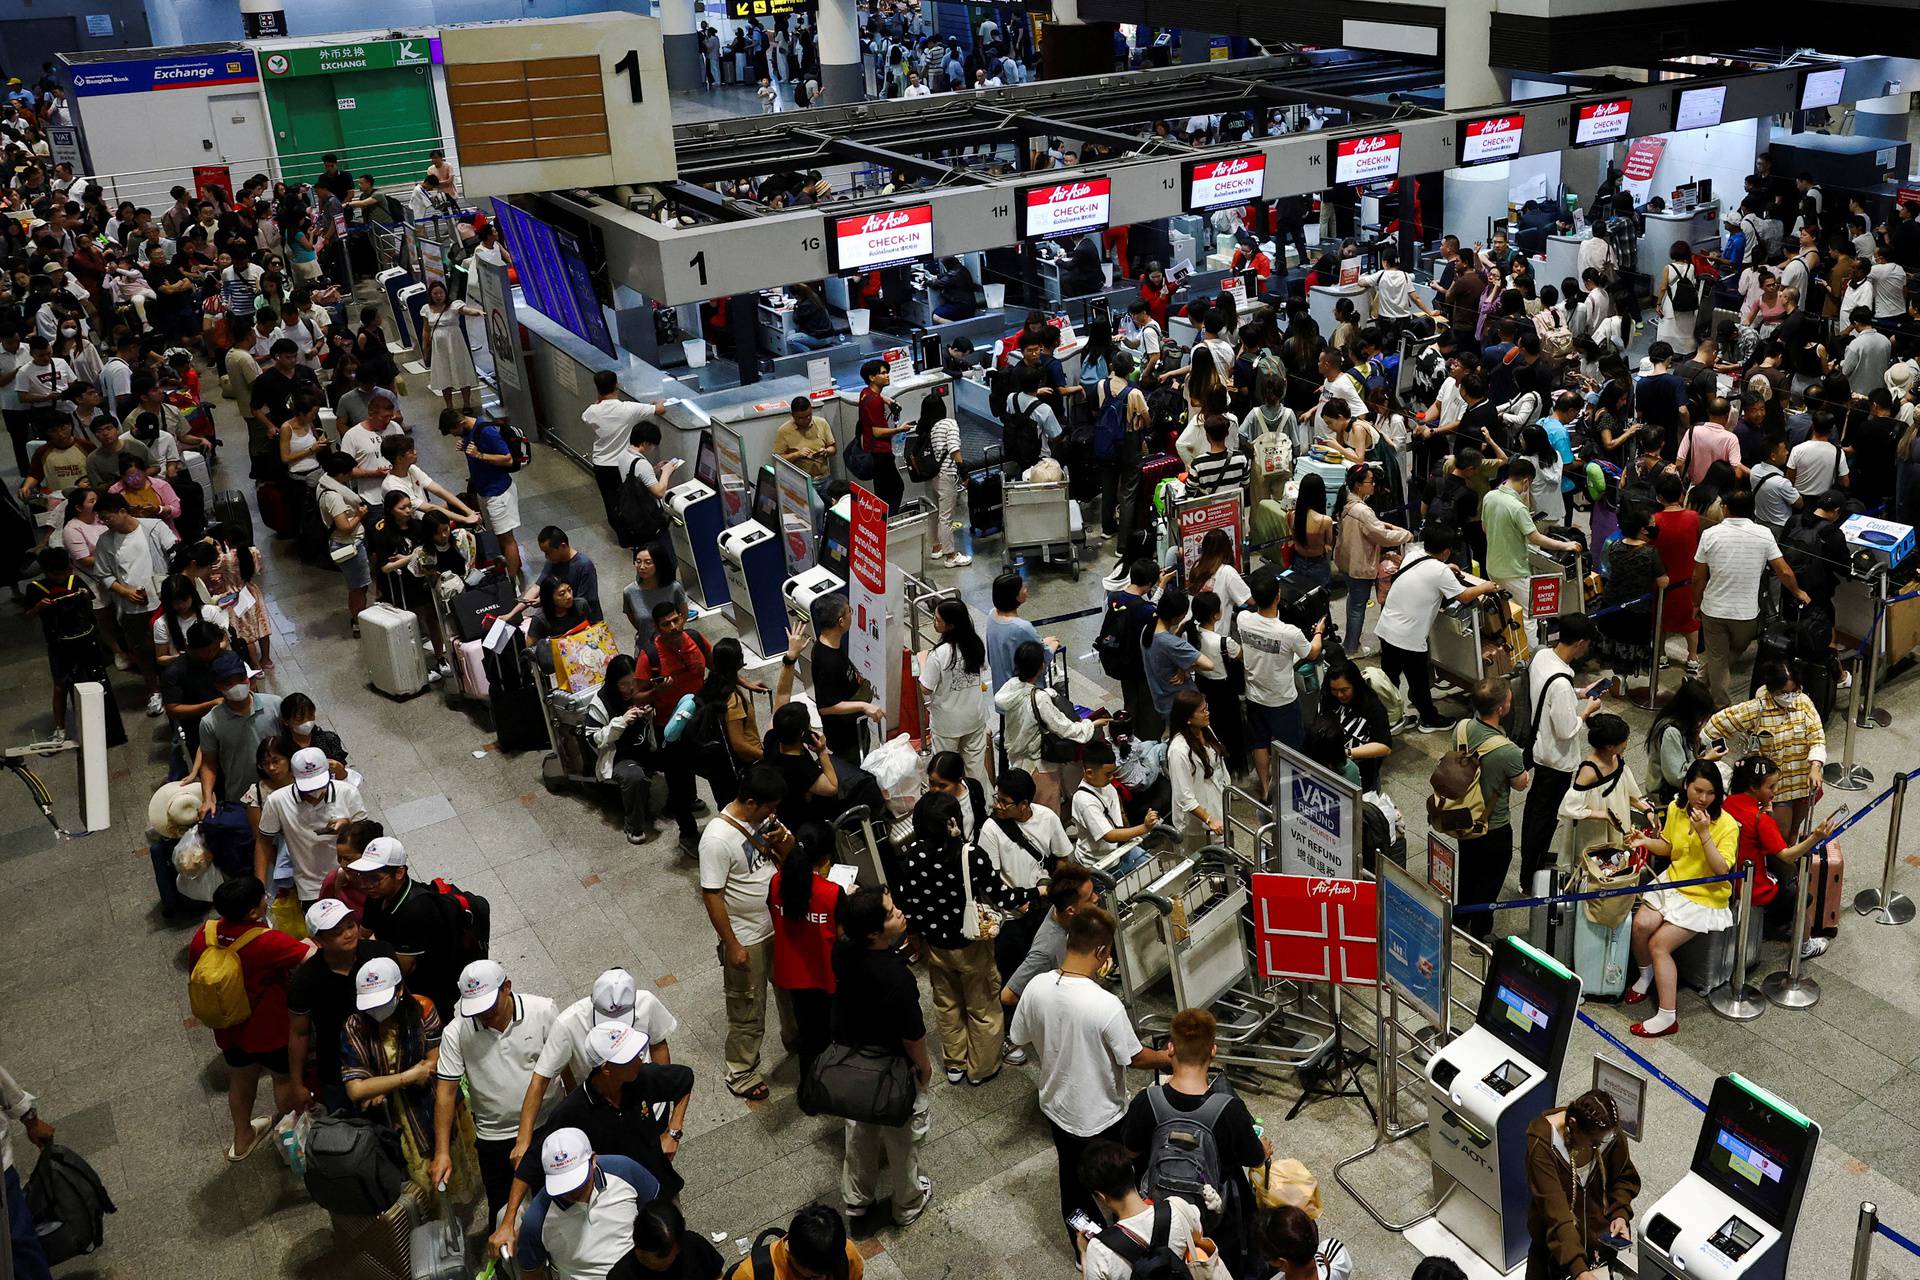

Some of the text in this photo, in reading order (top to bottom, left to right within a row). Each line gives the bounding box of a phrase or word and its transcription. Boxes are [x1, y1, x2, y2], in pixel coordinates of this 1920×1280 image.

[319, 47, 365, 59] 外币兑换
[321, 60, 367, 70] EXCHANGE
[153, 66, 215, 80] Exchange
[614, 50, 643, 103] 1
[85, 77, 113, 85] Bangkok
[1557, 117, 1568, 128] 1M
[1593, 119, 1622, 129] CHECK-IN
[1442, 137, 1452, 146] 1L
[1482, 136, 1514, 147] CHECK-IN
[1308, 155, 1320, 165] 1K
[1356, 155, 1391, 167] CHECK-IN
[1162, 178, 1174, 189] 1J
[1215, 178, 1254, 191] CHECK-IN
[1049, 183, 1091, 203] AirAsia
[992, 205, 1008, 217] 1H
[1053, 203, 1098, 217] CHECK-IN
[861, 211, 909, 234] AirAsia
[801, 238, 820, 251] 1G
[868, 231, 920, 249] CHECK-IN
[689, 251, 707, 285] 1
[1182, 510, 1207, 526] NO
[475, 603, 501, 615] CHANEL
[1298, 778, 1335, 815] VAT
[1298, 802, 1335, 830] REFUND
[1291, 828, 1342, 867] VAT REFUND
[1312, 880, 1352, 897] AirAsia
[1461, 1145, 1487, 1167] AOT
